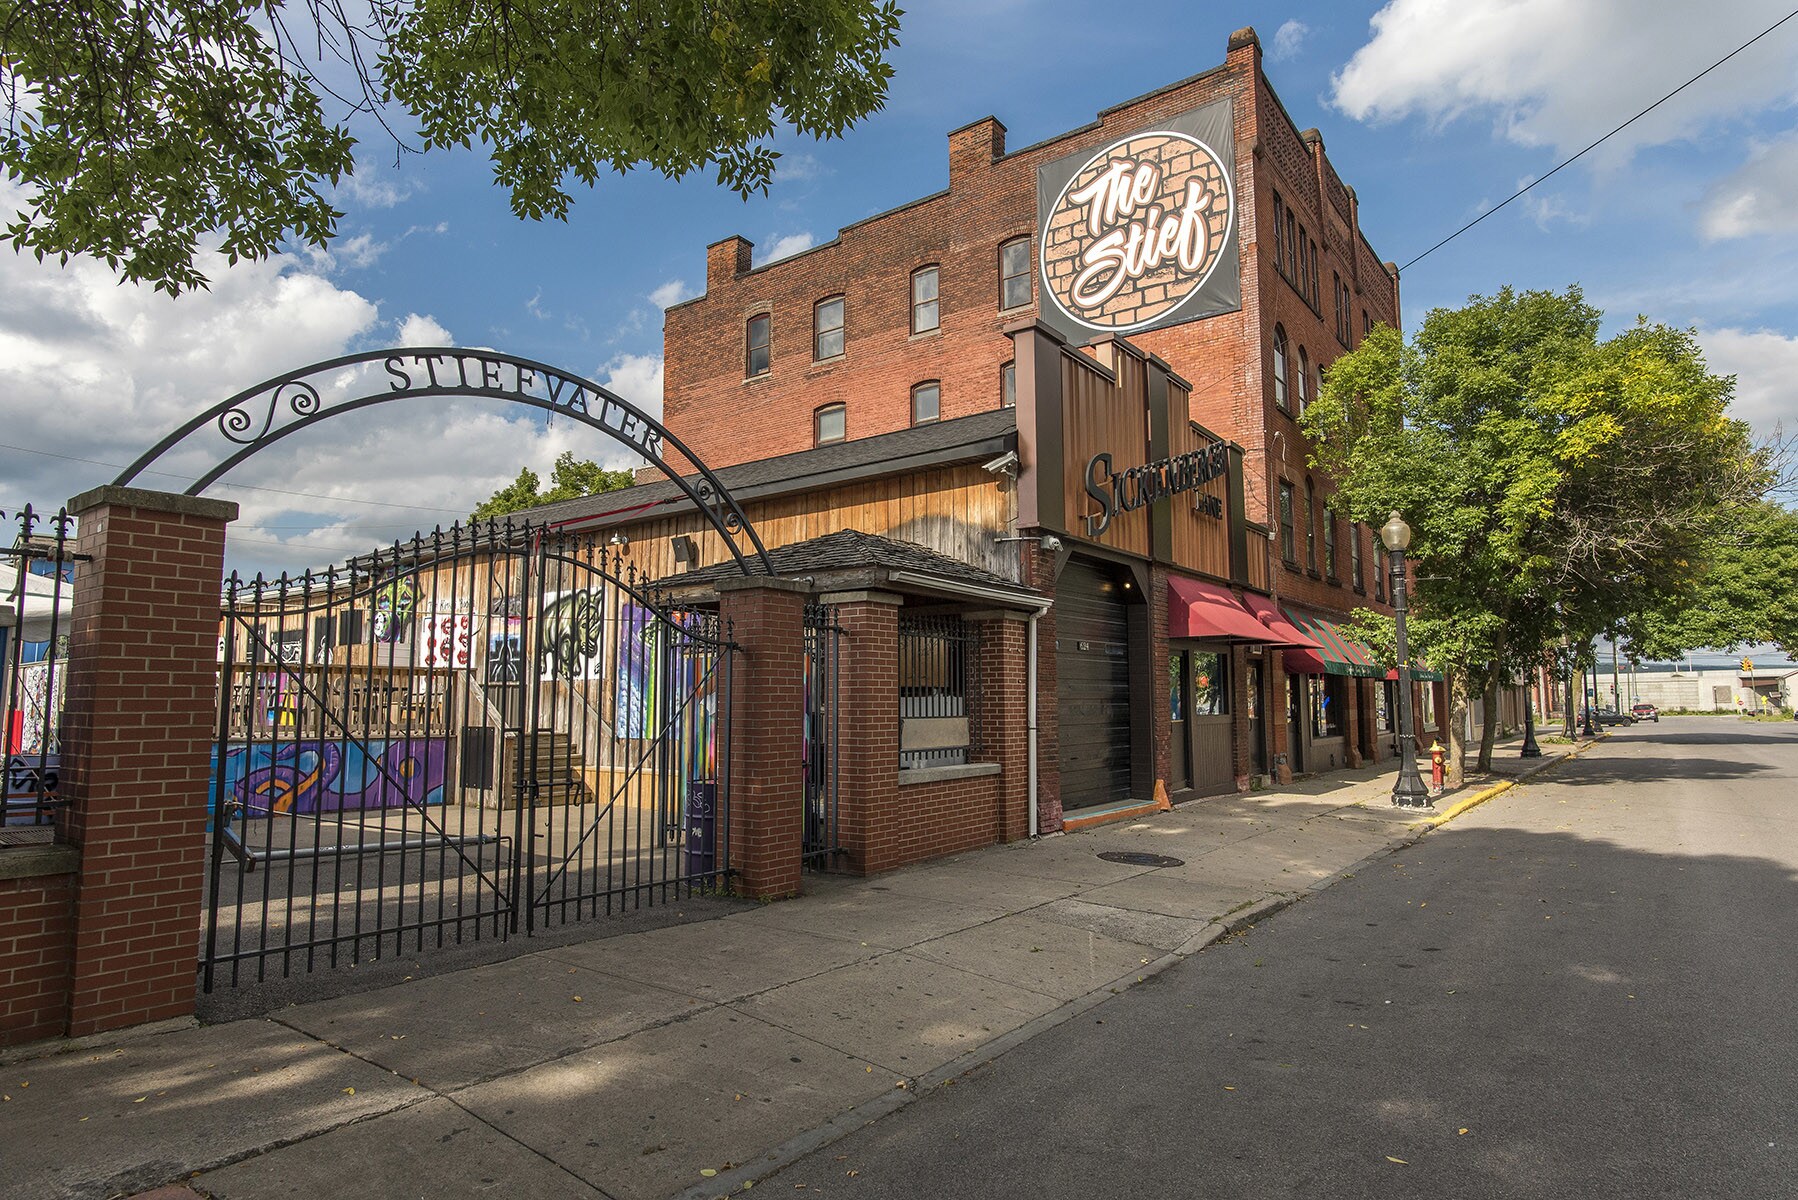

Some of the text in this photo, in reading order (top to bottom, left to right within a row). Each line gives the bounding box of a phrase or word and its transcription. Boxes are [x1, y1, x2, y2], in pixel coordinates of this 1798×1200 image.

[1069, 159, 1161, 237] The
[1072, 178, 1210, 308] Stief
[384, 354, 664, 461] STIEFVATER
